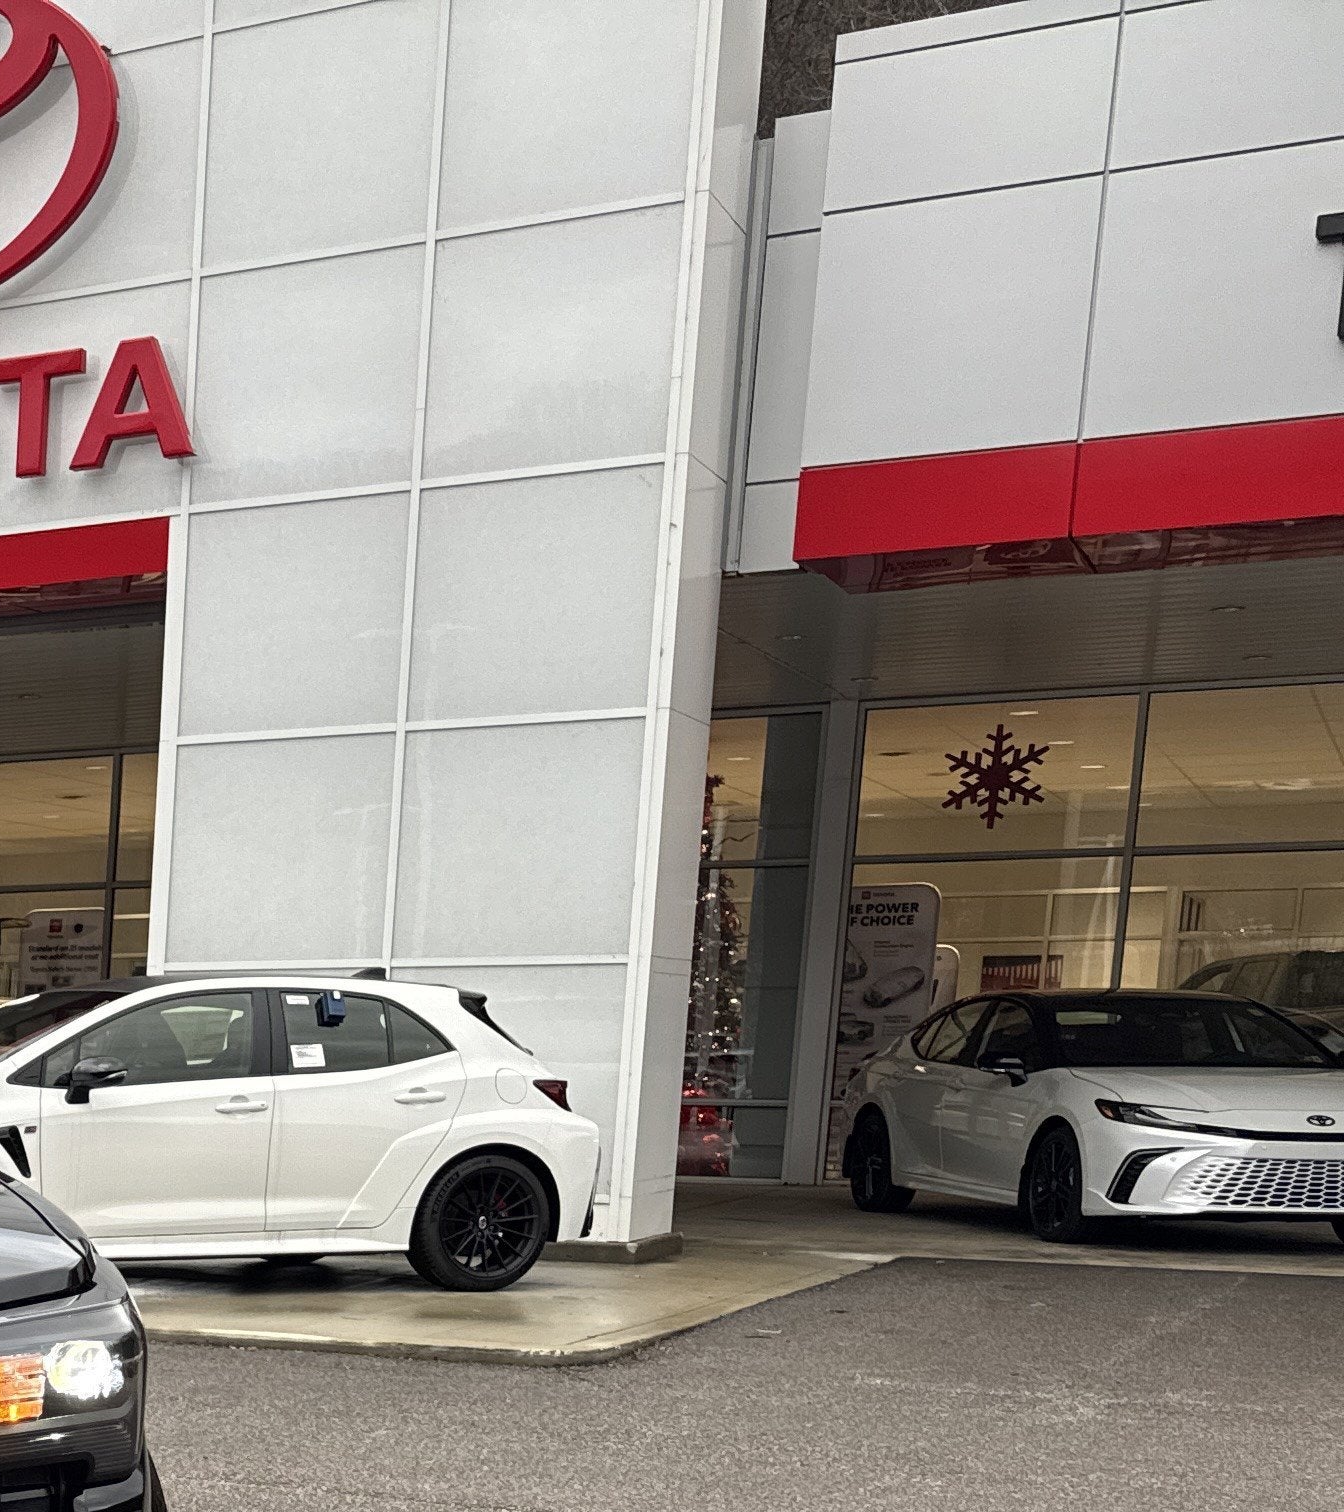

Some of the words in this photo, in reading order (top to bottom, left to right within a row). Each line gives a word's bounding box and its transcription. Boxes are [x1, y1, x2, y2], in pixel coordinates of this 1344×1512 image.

[865, 902, 920, 914] POWER
[850, 916, 858, 927] F
[860, 914, 915, 927] CHOICE
